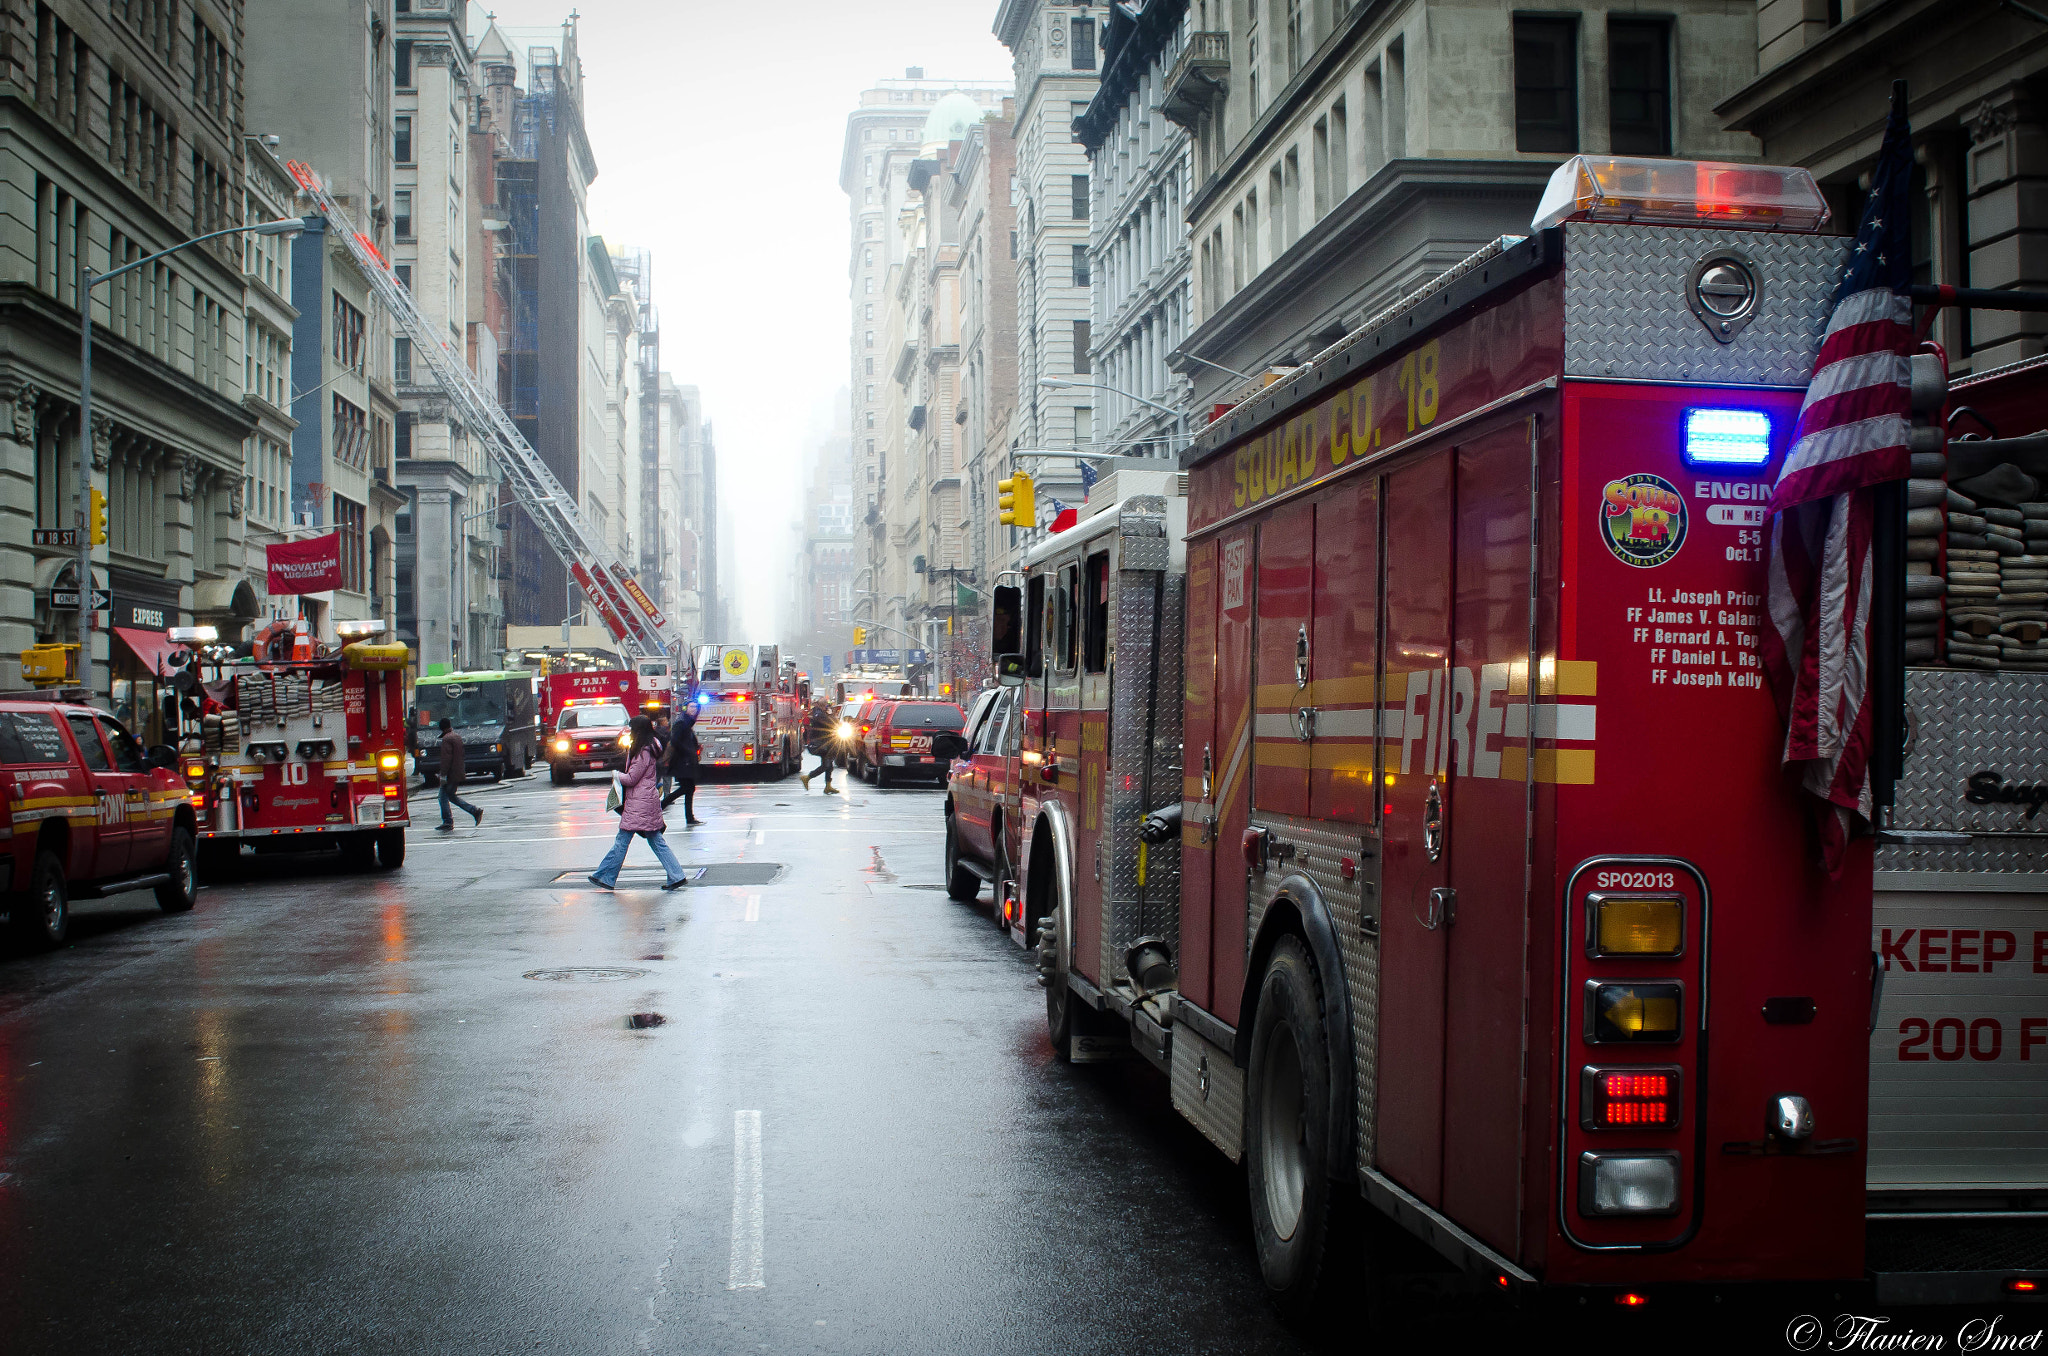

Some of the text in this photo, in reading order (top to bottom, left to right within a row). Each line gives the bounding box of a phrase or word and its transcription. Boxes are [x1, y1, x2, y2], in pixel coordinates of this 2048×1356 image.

[1235, 338, 1440, 508] SQUAD CO. 18
[1628, 475, 1661, 485] FDNY
[1605, 481, 1681, 518] SQUAD
[1694, 481, 1774, 501] ENGIN
[1627, 506, 1670, 541] 18
[1722, 509, 1767, 522] IN ME
[36, 532, 74, 544] W 18 ST
[1225, 544, 1244, 574] FAST
[1612, 546, 1675, 567] MANHATTAN
[1725, 546, 1763, 562] Oct. 1
[271, 558, 337, 573] INNOVATION
[284, 568, 326, 580] LUGGAGE
[59, 594, 76, 603] ONE
[1226, 576, 1242, 605] PAK
[1648, 587, 1666, 603] Lt.
[1671, 588, 1721, 607] Joseph
[624, 579, 664, 626] LADDER 3
[132, 608, 164, 627] EXPRESS
[1626, 607, 1761, 626] FF James V. Galana
[1633, 628, 1760, 649] FF Bernard A. Tep
[1650, 649, 1667, 664] FF
[1671, 649, 1716, 665] Daniel
[1721, 650, 1733, 666] L.
[573, 676, 610, 686] F.D.N.Y.
[650, 678, 657, 688] 5
[1652, 669, 1763, 690] FF Joseph Kelly
[710, 715, 735, 726] FDNY
[1400, 662, 1510, 779] FIRE
[909, 736, 933, 748] FDN
[280, 763, 308, 786] 10
[100, 794, 125, 825] FDNY
[1880, 928, 2017, 974] KEEP
[1898, 1017, 2003, 1062] 200
